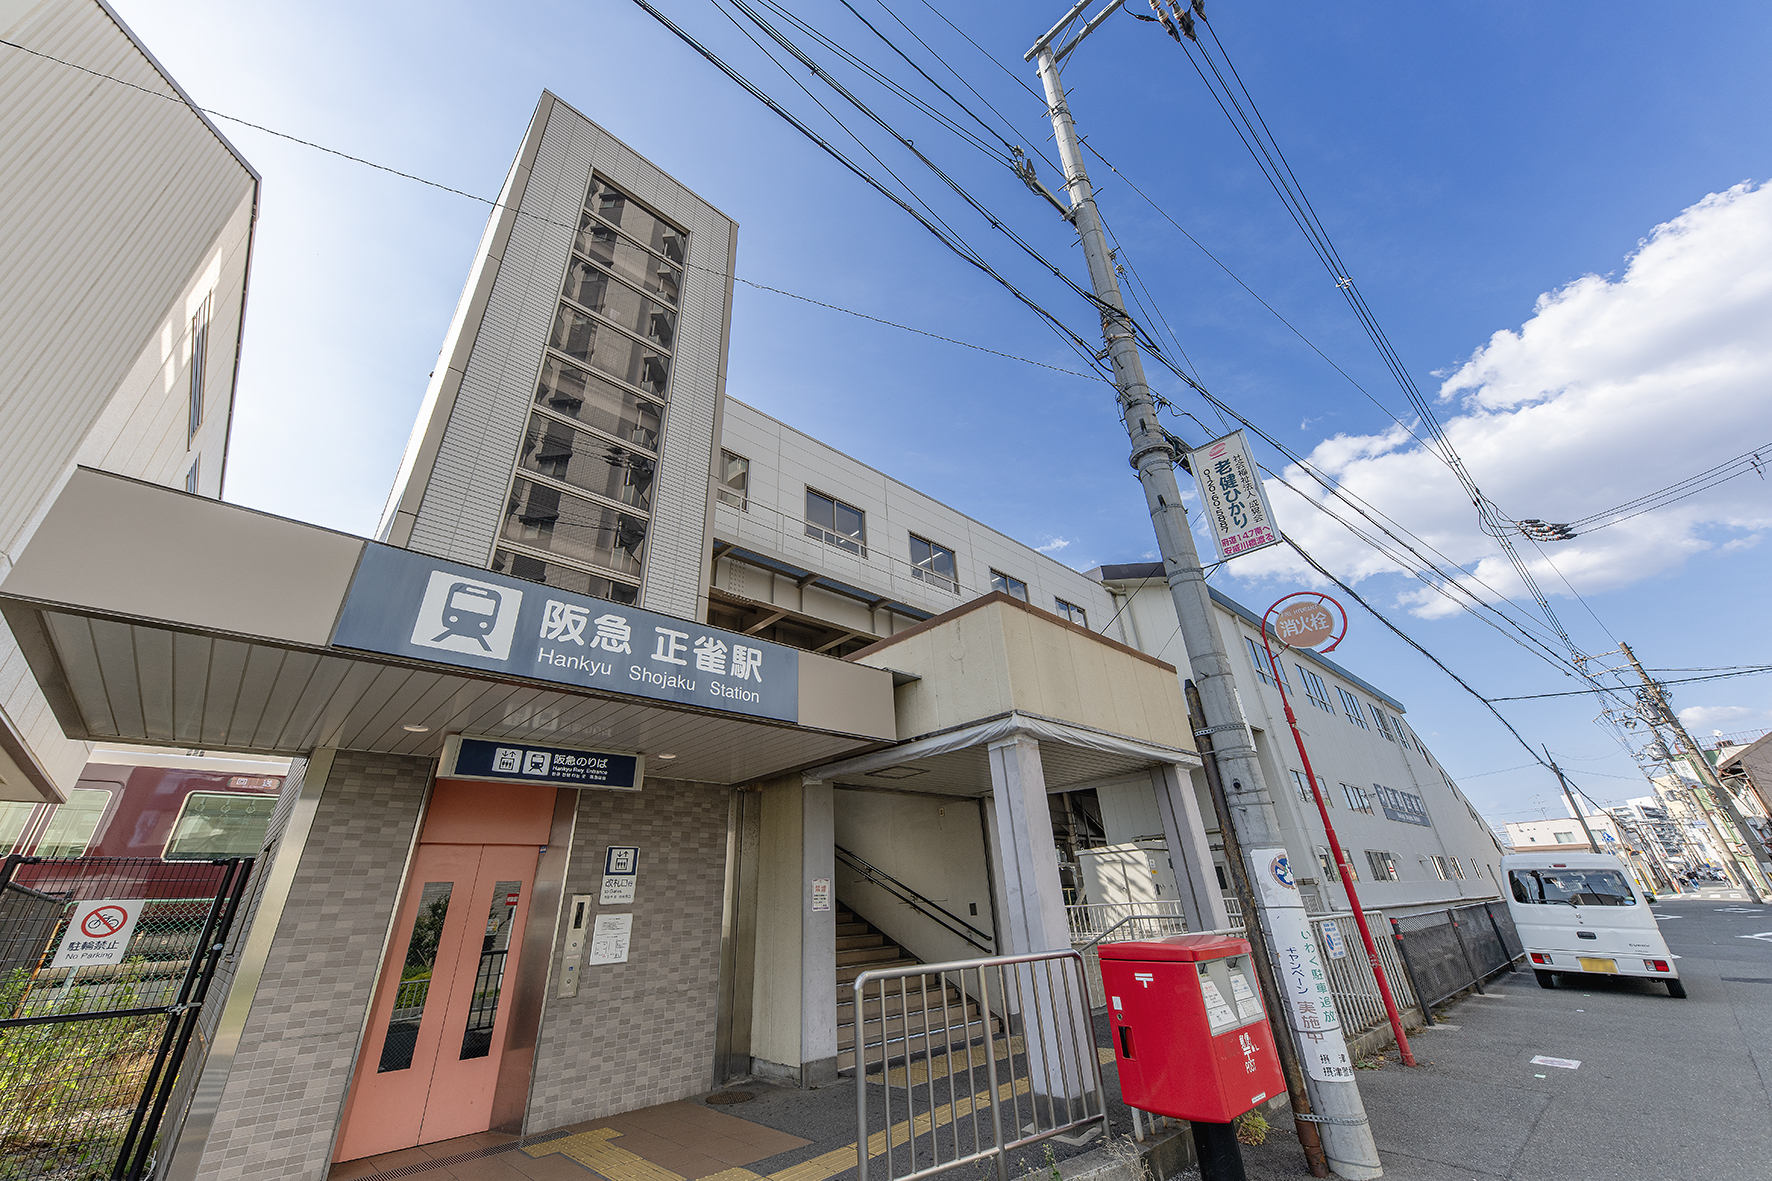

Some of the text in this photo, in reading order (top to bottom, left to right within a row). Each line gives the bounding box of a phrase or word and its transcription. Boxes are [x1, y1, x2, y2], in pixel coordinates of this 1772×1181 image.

[1214, 458, 1248, 529] 老健ひかり
[1279, 611, 1330, 638] 消火栓
[539, 599, 763, 683] 阪急 正雀駅
[537, 647, 760, 703] Hankyu Shojaku Station
[552, 765, 573, 773] Hankyu
[586, 768, 608, 776] Entrance
[553, 753, 609, 769] 阪急のりば
[66, 940, 120, 952] 駐輪禁止
[80, 952, 114, 960] Parking
